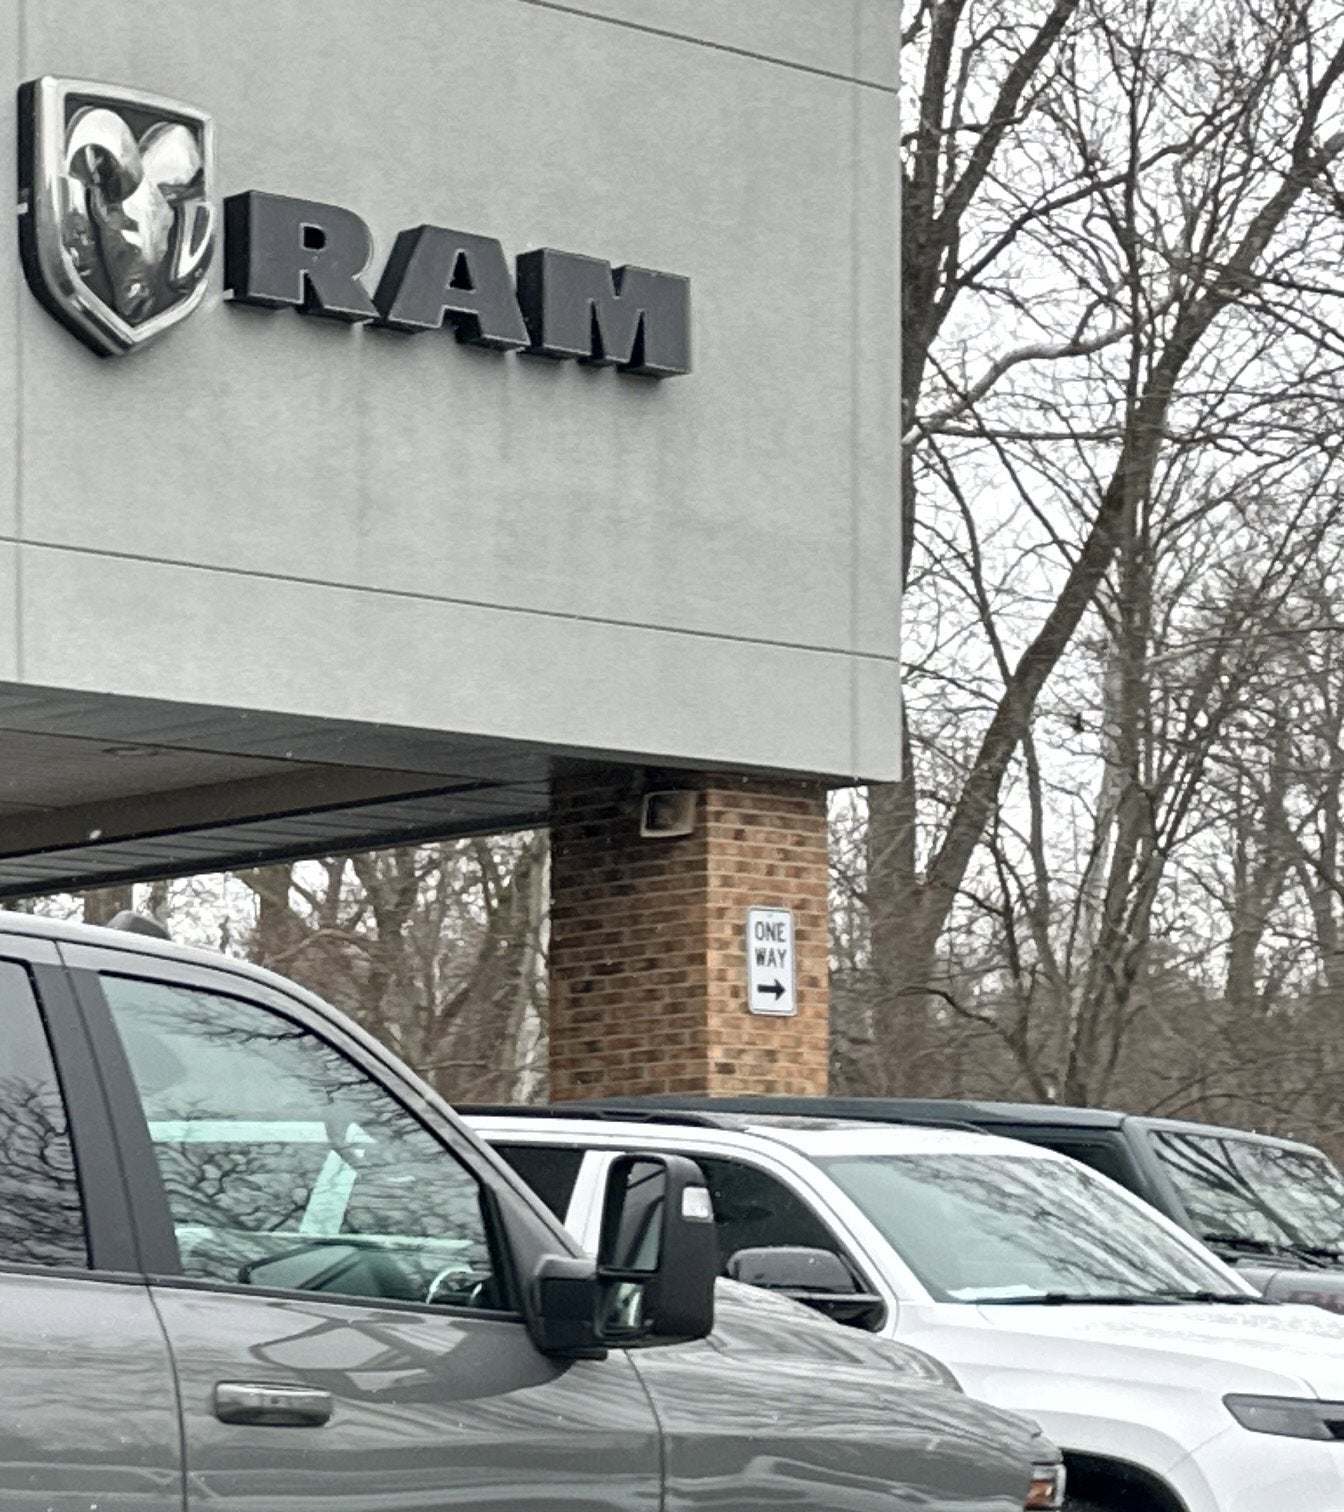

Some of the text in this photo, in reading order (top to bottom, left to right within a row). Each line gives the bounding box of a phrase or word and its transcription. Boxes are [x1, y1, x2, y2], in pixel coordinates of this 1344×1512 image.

[223, 189, 692, 378] RAM
[755, 921, 786, 942] ONE
[755, 947, 787, 969] WAY
